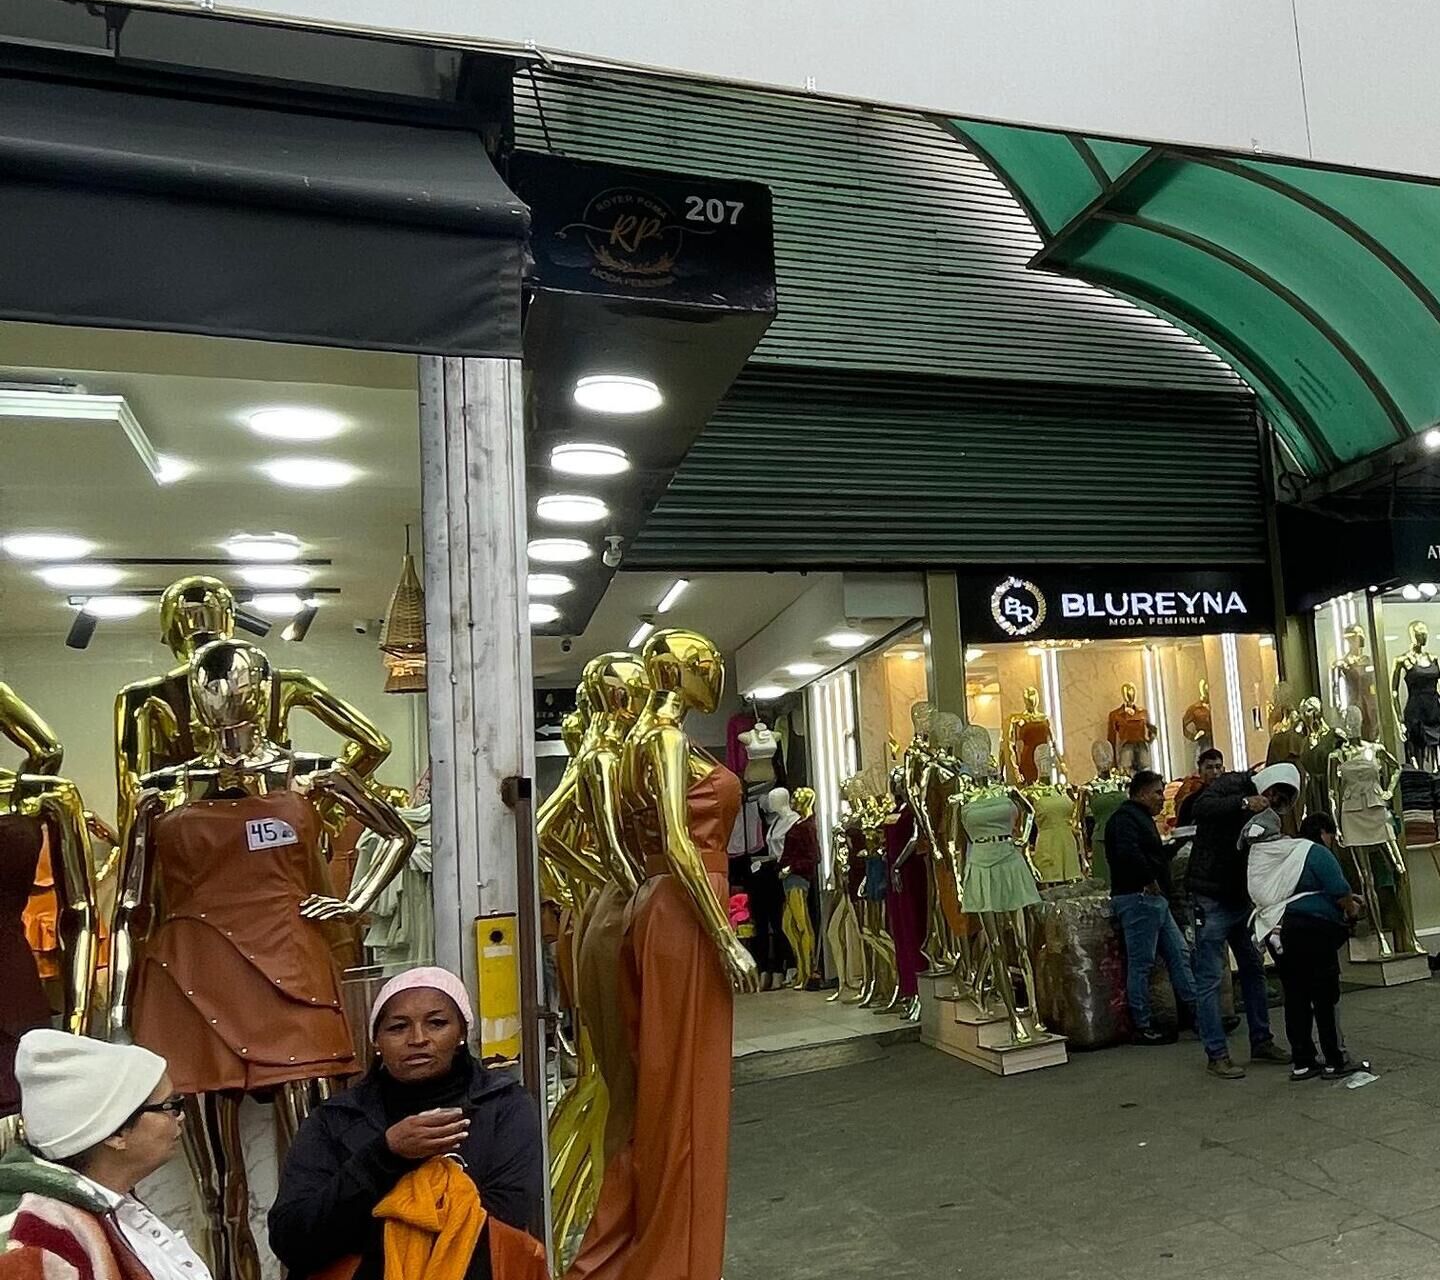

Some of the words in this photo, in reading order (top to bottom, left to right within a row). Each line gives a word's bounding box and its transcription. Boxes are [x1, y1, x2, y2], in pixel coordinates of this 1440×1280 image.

[684, 195, 745, 225] 207
[1004, 596, 1034, 622] BR
[1061, 591, 1248, 617] BLUREYNA
[1109, 617, 1143, 626] MODA
[1149, 616, 1206, 625] FEMININA
[250, 822, 278, 843] 45
